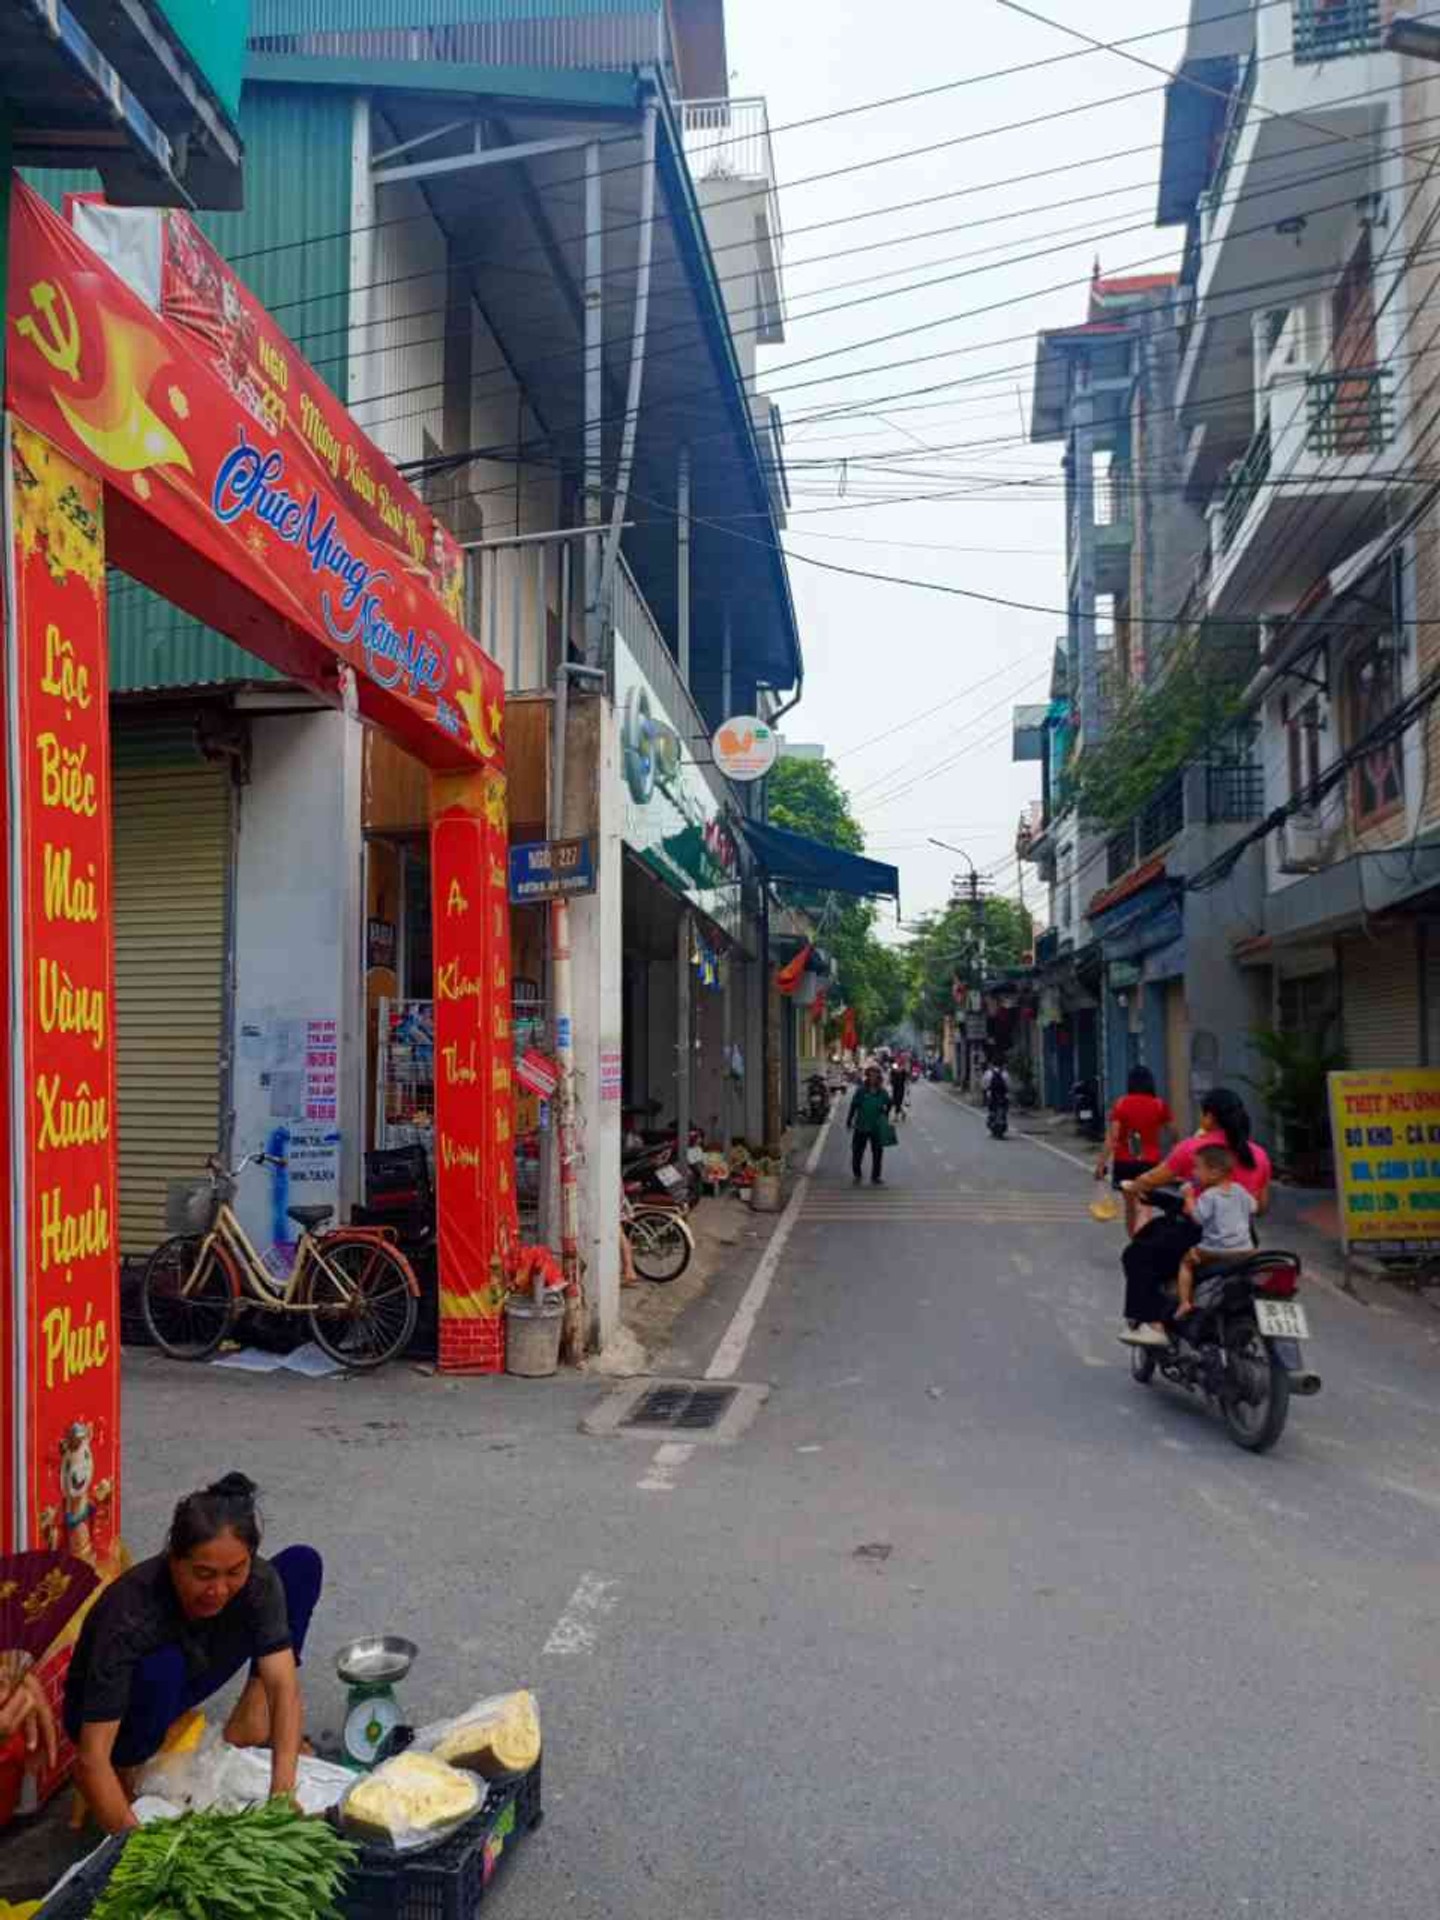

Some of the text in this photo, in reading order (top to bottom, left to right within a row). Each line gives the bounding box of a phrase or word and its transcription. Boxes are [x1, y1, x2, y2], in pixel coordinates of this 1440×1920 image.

[36, 623, 109, 1389] Lộc Biếc Mai Vàng Xuân Hạnh Phúc
